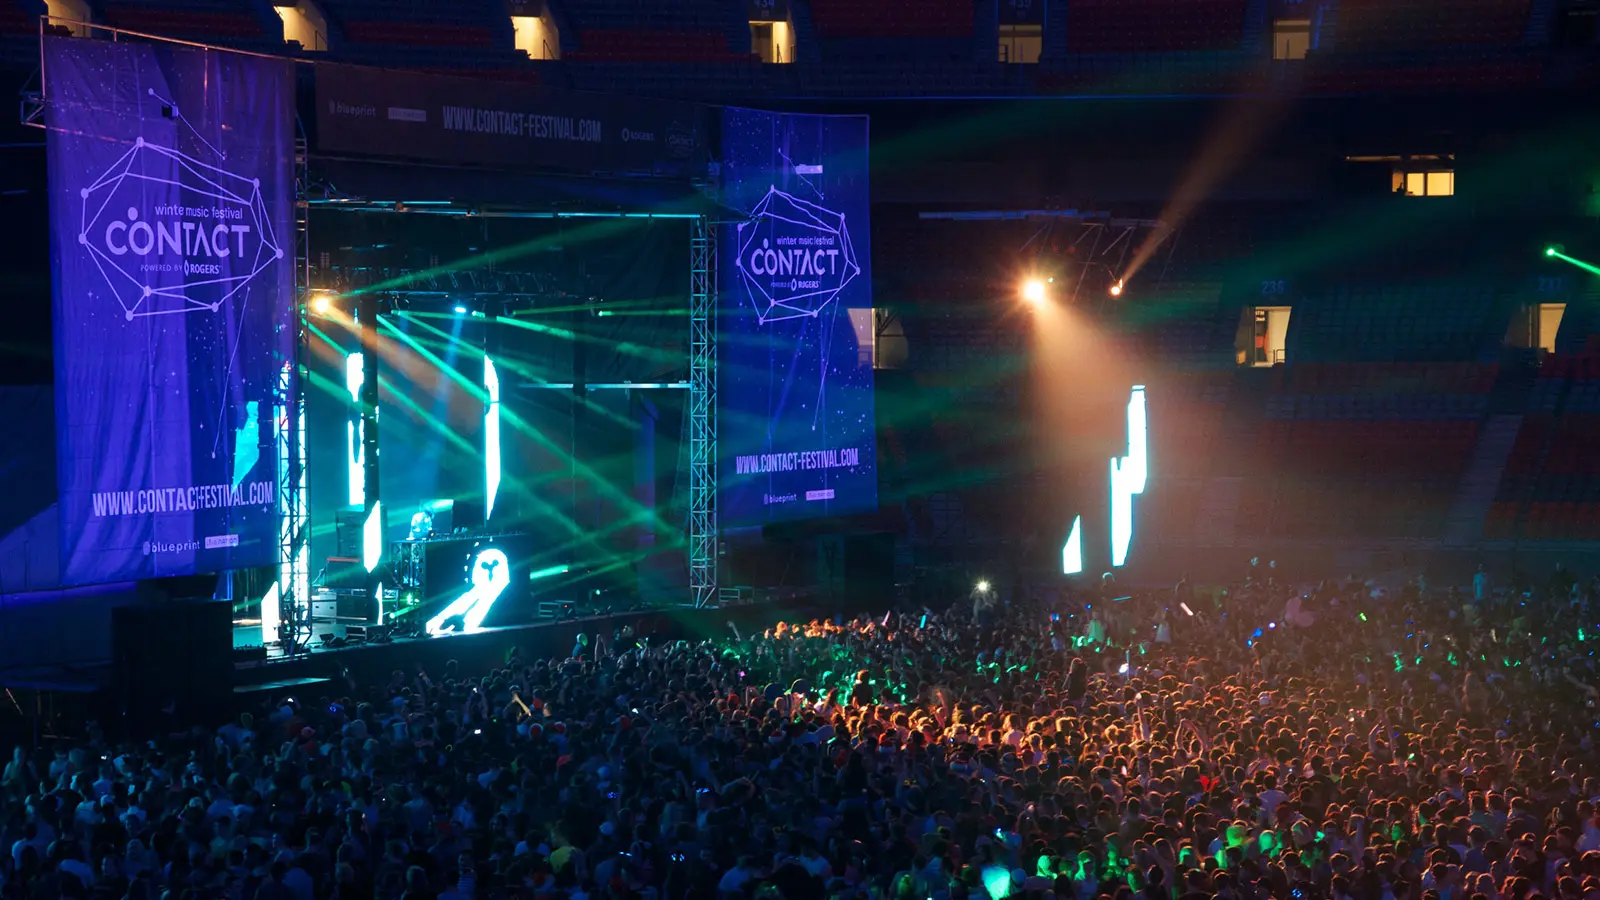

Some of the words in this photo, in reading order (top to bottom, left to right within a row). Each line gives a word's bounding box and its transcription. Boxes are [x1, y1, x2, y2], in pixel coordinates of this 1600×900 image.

[336, 101, 377, 118] blueprint
[442, 105, 601, 143] WWW.CONTACT-FESTIVAL.COM
[154, 203, 185, 216] winte
[185, 205, 209, 218] music
[212, 206, 243, 219] festival
[105, 220, 250, 258] CONTACT
[140, 264, 172, 272] POWERED
[190, 264, 220, 275] ROGERS
[751, 248, 839, 276] CONTACT
[736, 447, 859, 475] WWW.CONTACT-FESTIVAL.COM
[152, 539, 200, 554] blueprint
